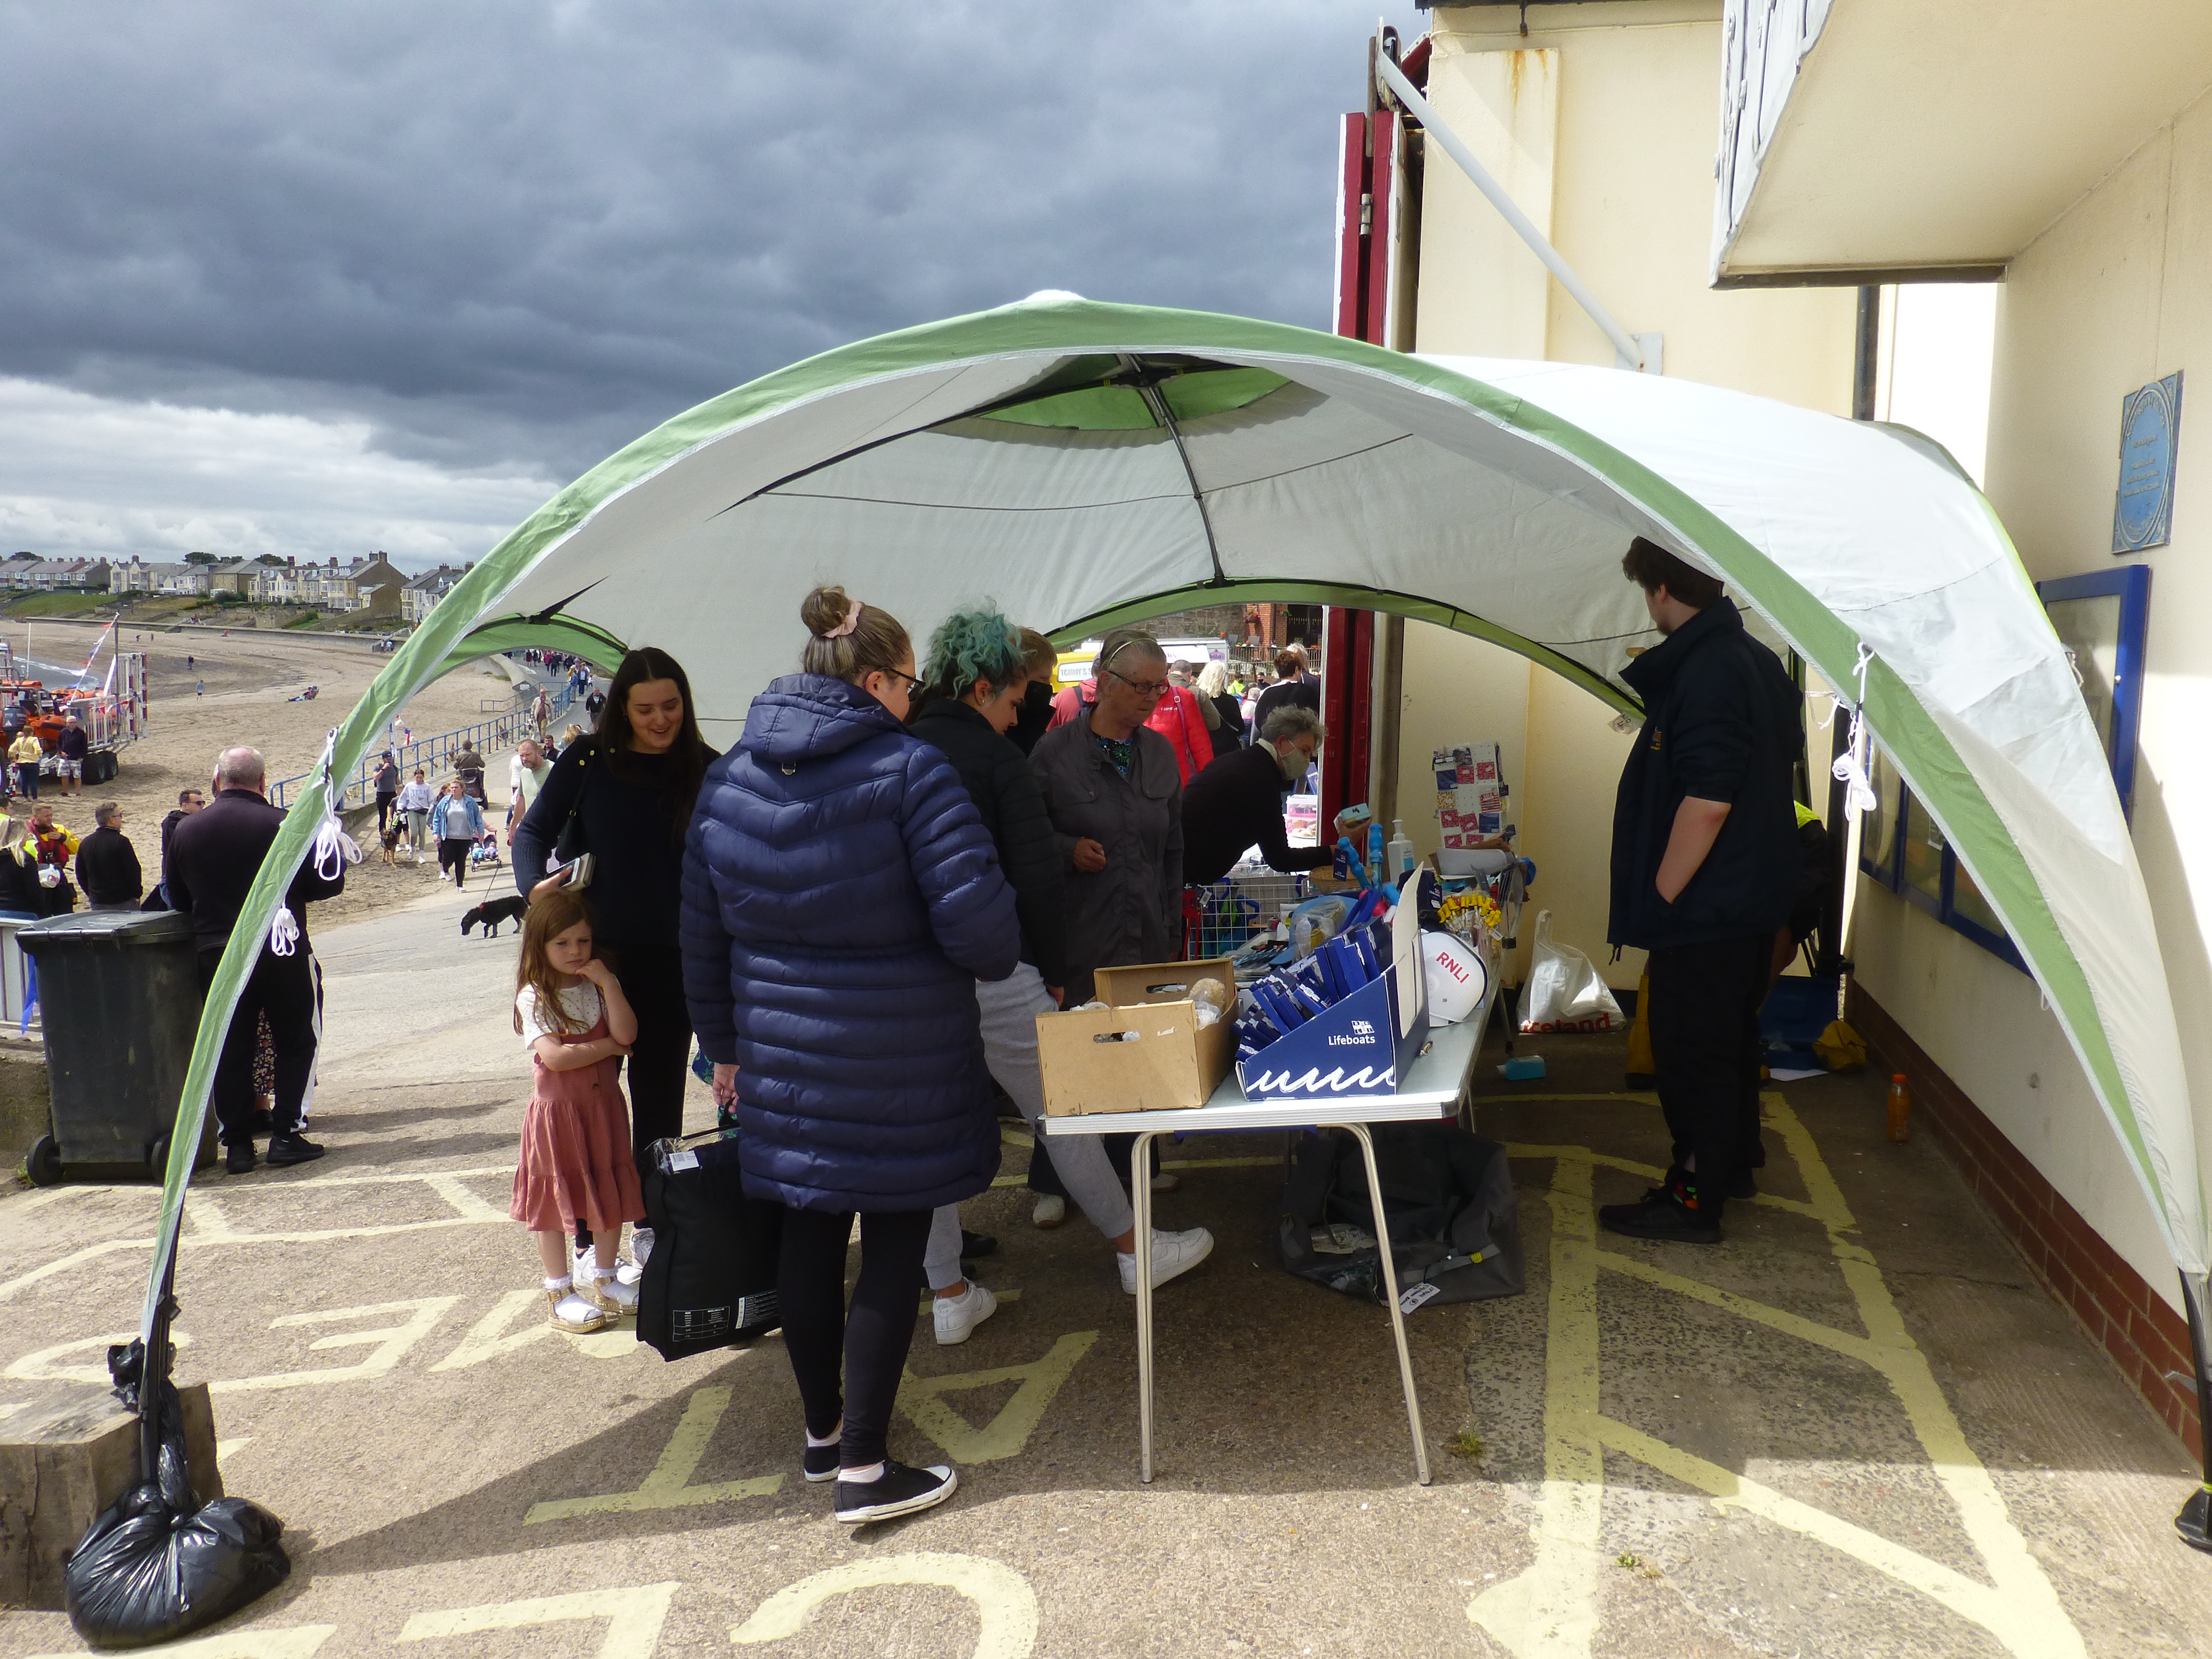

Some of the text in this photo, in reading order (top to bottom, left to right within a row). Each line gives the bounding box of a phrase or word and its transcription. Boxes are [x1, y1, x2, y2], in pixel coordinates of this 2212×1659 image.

[1060, 668, 1087, 676] TOMMY'S
[1435, 951, 1470, 984] RNLI
[1328, 1034, 1375, 1046] Lifeboats
